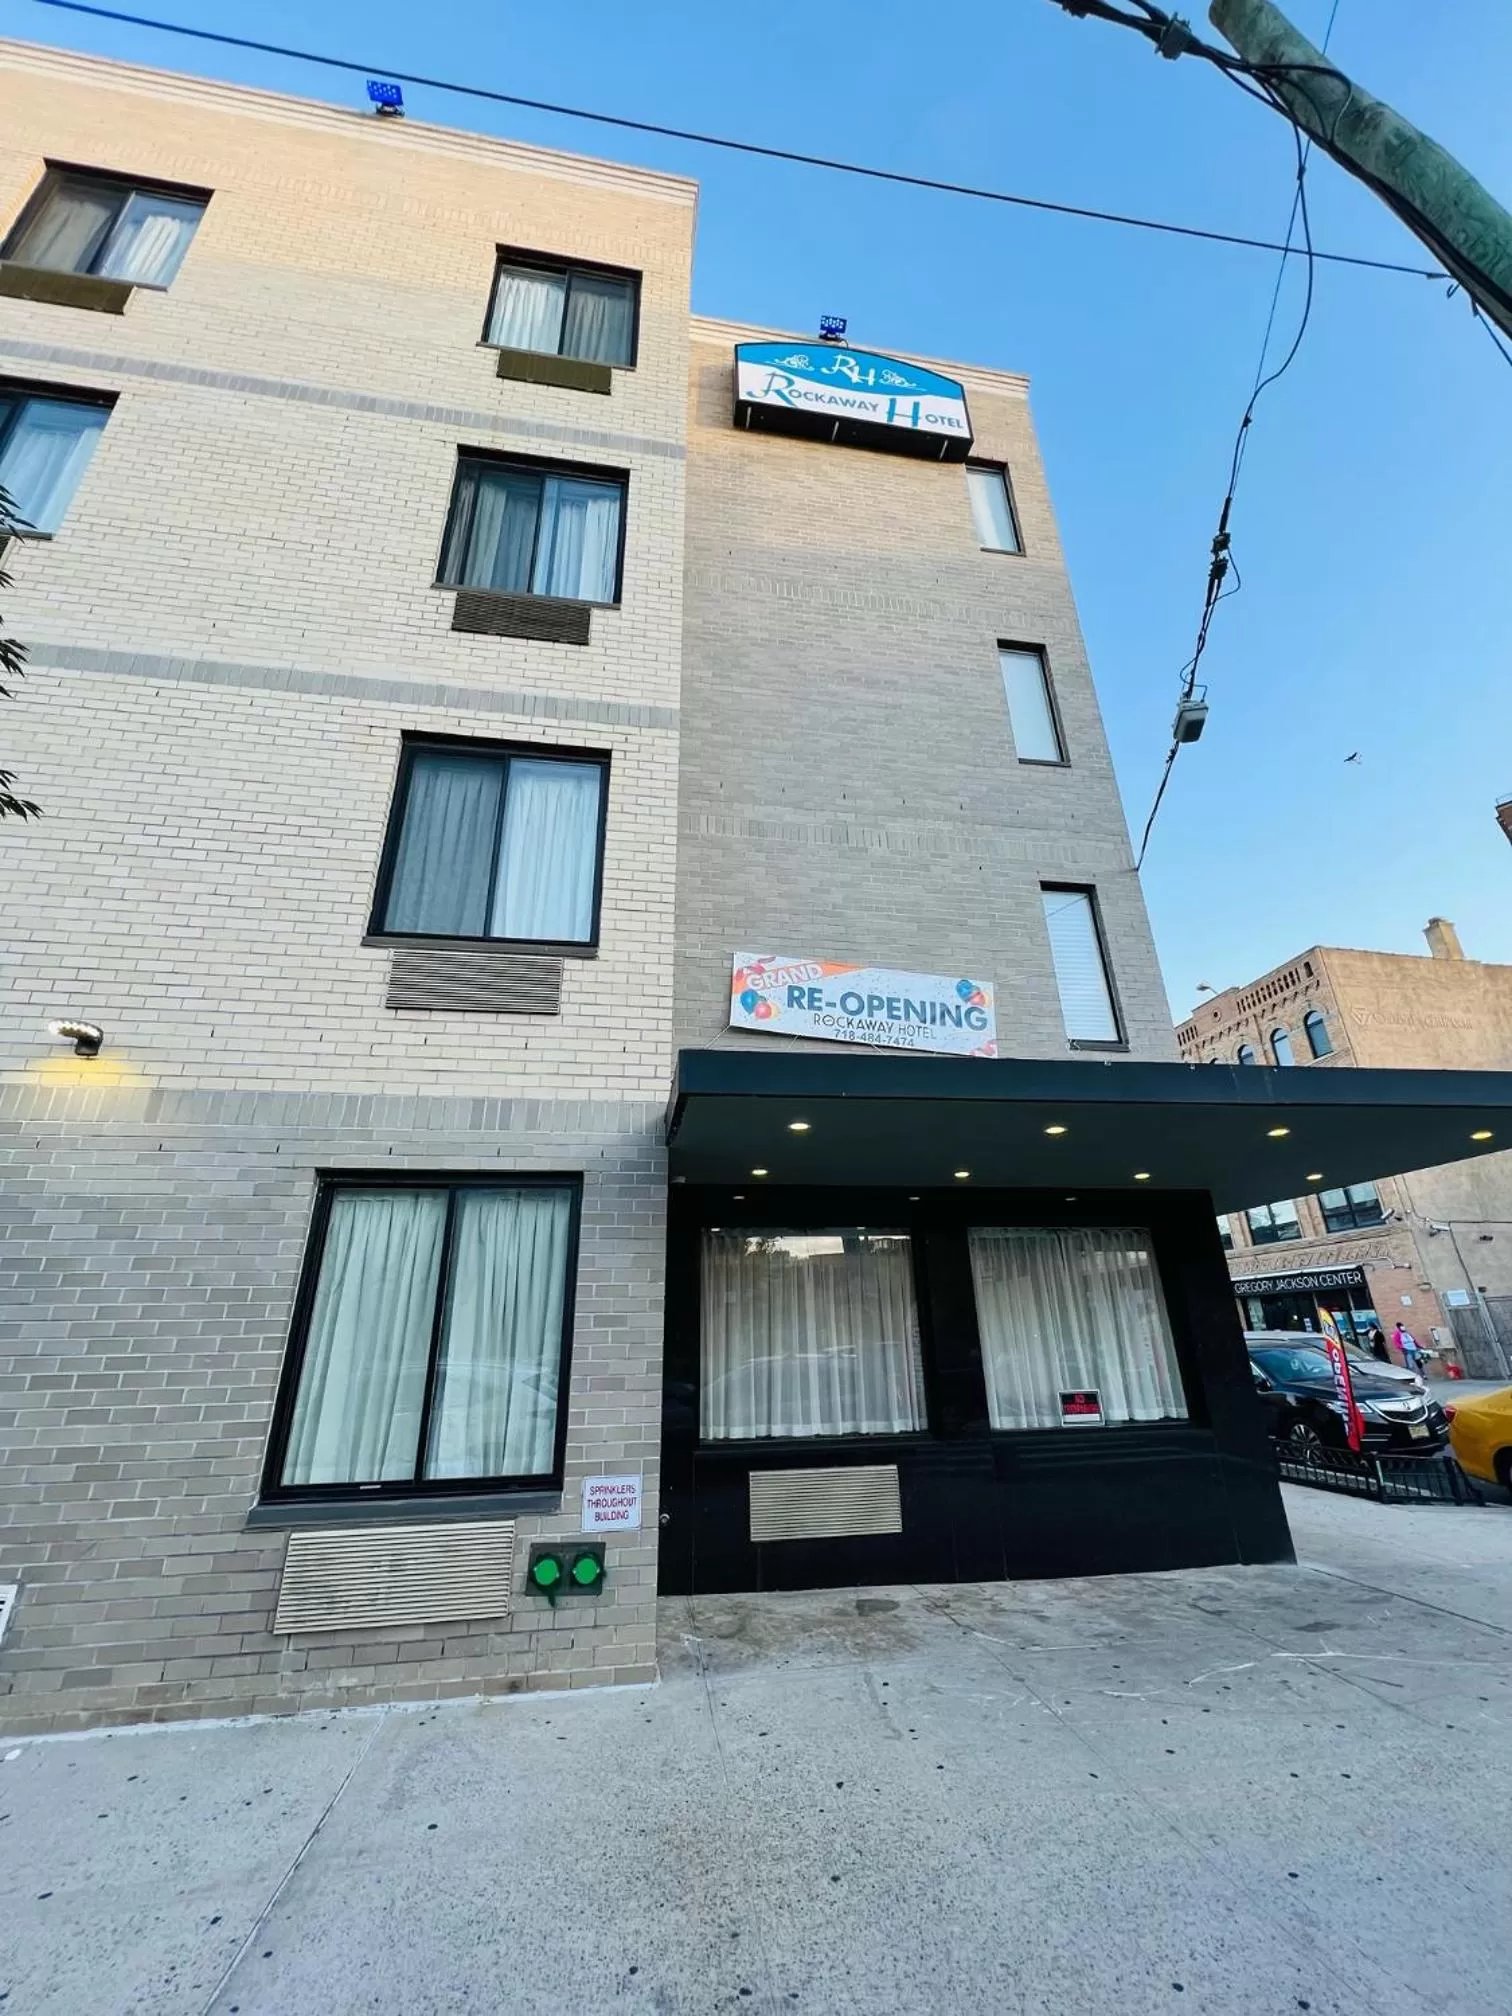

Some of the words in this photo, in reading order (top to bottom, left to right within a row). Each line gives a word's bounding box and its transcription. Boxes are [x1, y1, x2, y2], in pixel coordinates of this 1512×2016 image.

[746, 371, 879, 408] ROCKAWAY
[886, 397, 964, 430] HOTEL
[745, 963, 824, 990] GRAND
[786, 984, 989, 1032] RE-OPENING
[813, 1013, 895, 1035] ROCKAWAY
[898, 1023, 937, 1040] HOTEL
[834, 1029, 915, 1048] 718-484-7474
[1234, 1280, 1273, 1294] GREGORY
[1276, 1276, 1319, 1291] JACKSON
[1319, 1270, 1363, 1286] CENTER
[589, 1483, 636, 1496] SPRINKLERS
[587, 1497, 637, 1509] THROUGHOUT
[594, 1510, 629, 1522] BUILDING
